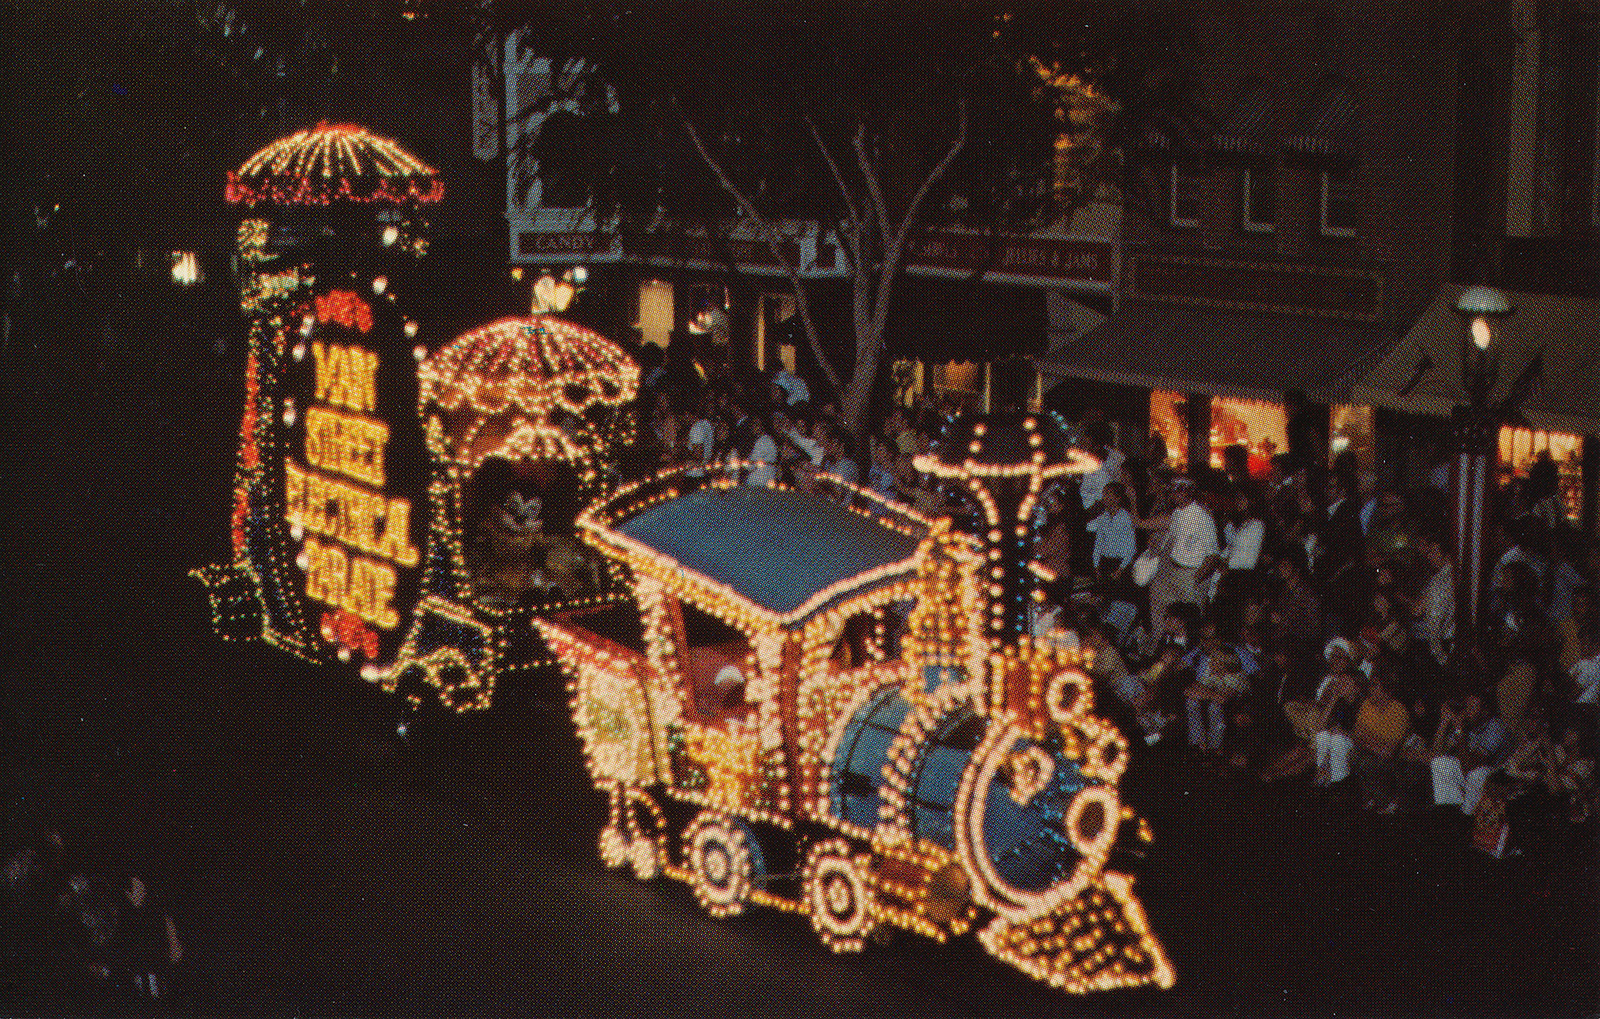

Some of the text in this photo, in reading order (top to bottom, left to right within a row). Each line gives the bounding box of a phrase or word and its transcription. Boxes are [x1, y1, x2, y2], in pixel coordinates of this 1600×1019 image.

[534, 235, 595, 250] CANDY
[1063, 251, 1099, 270] JAMS
[305, 407, 389, 486] STREET
